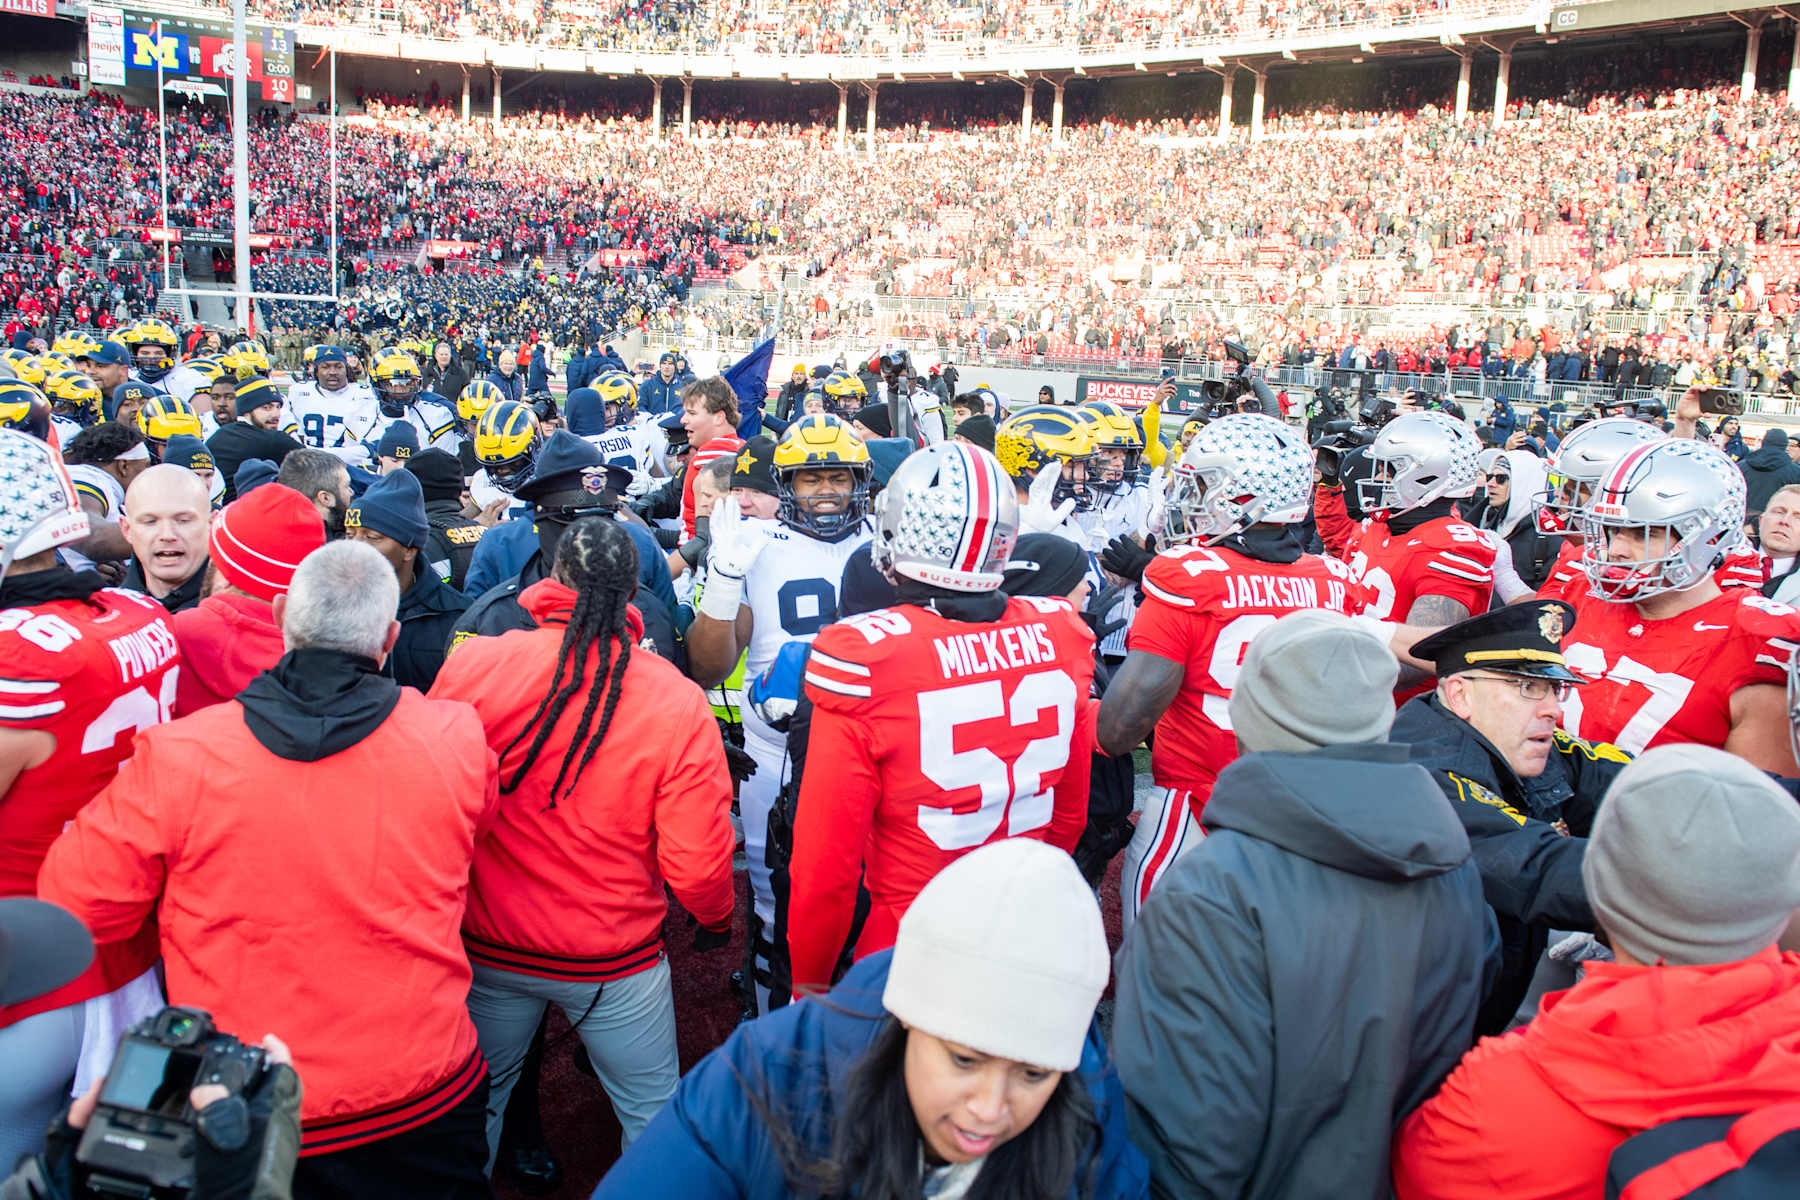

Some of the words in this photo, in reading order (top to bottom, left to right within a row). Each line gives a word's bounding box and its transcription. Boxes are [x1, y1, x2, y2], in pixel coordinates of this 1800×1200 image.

[1559, 12, 1576, 24] CC
[132, 33, 179, 69] M
[271, 39, 287, 52] 13
[267, 62, 290, 74] 0:00
[271, 78, 289, 92] 10
[125, 388, 142, 399] M
[303, 413, 345, 448] 97
[396, 446, 411, 458] M
[594, 435, 632, 454] RSON
[345, 509, 361, 527] M
[1222, 574, 1317, 609] JACKSON
[1323, 579, 1346, 612] JR
[108, 618, 178, 683] POWERS
[933, 622, 1057, 679] MICKENS
[916, 668, 1078, 851] 52
